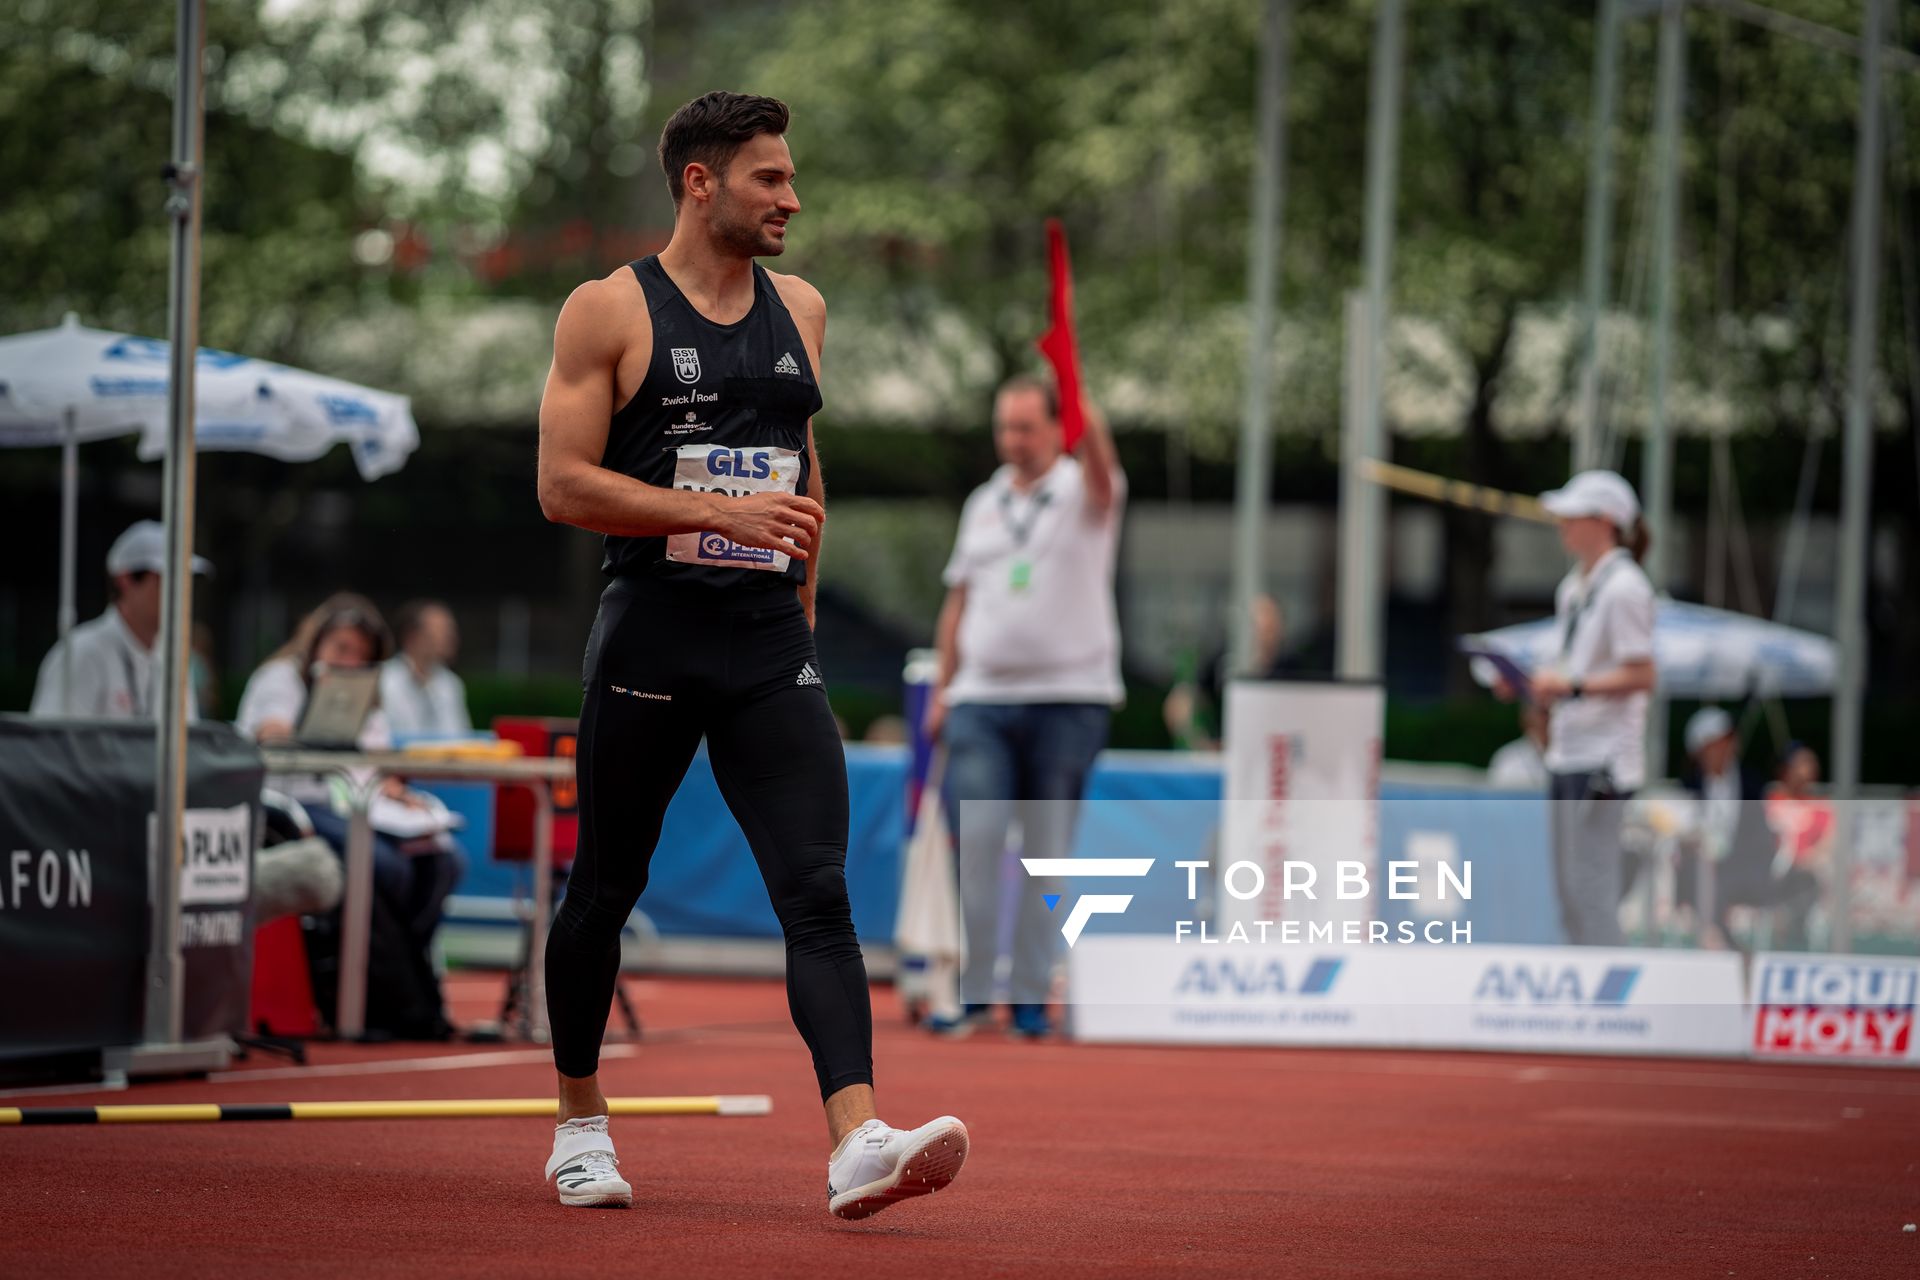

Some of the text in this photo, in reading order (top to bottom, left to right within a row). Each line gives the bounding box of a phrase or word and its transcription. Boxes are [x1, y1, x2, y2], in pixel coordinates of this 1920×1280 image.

[673, 349, 695, 358] SSV
[674, 357, 698, 365] 1846
[730, 551, 772, 560] INTERNATIONAL
[610, 684, 673, 701] TOP4RUNNING
[0, 848, 92, 910] FON
[1176, 957, 1287, 993] ANA
[1475, 962, 1584, 1004] ANA
[1762, 1009, 1910, 1052] MOLY
